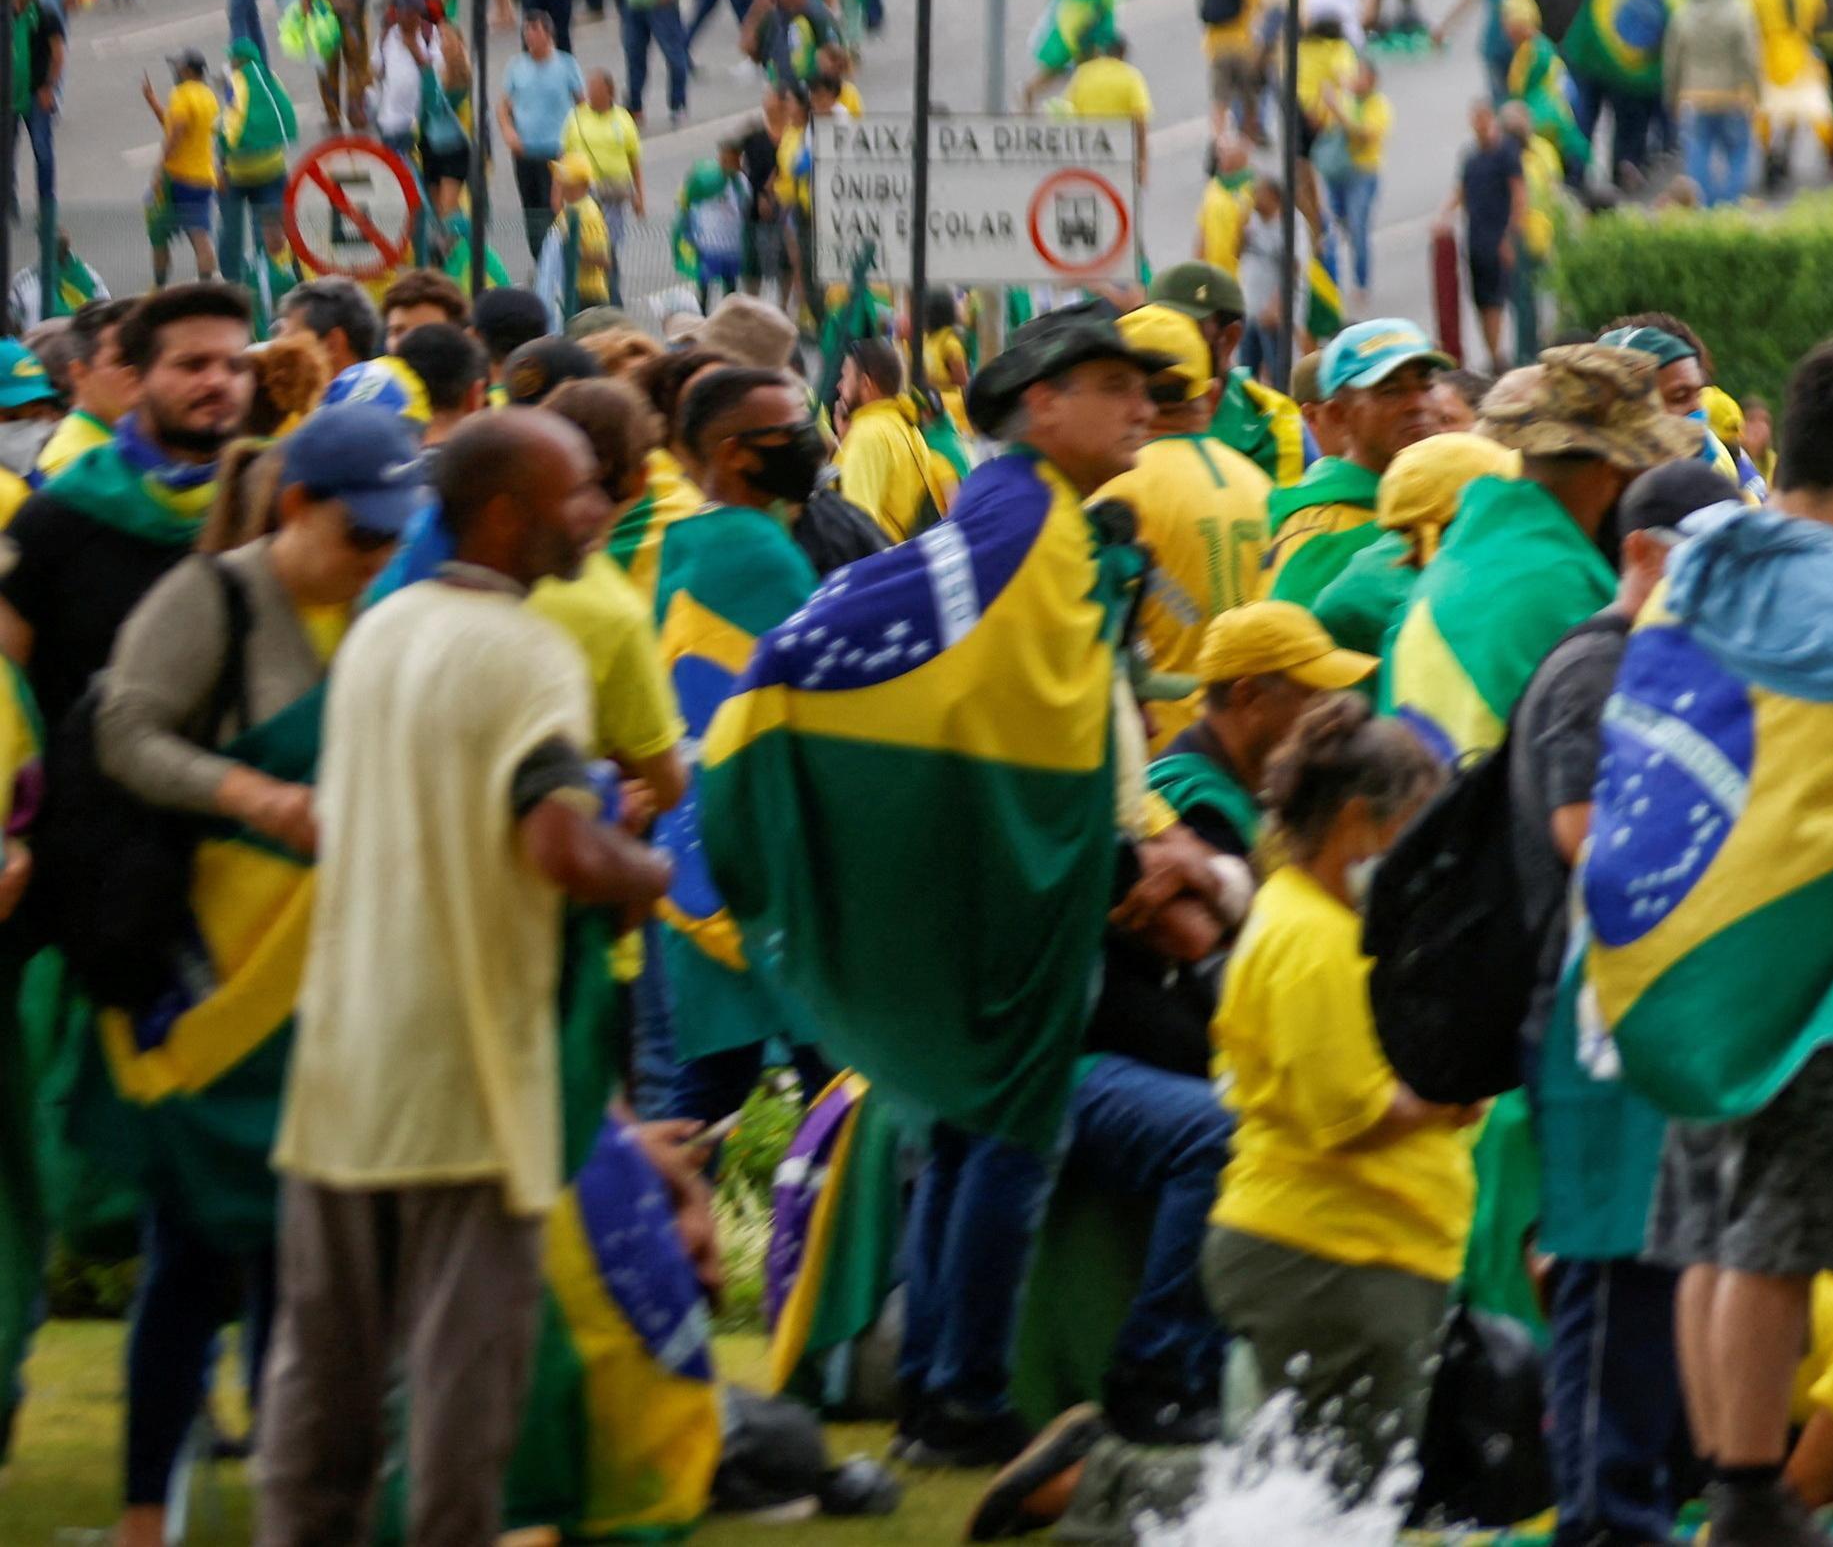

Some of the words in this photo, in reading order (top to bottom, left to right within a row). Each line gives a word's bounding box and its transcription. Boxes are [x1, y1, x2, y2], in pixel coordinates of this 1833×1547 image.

[939, 125, 979, 152] DA
[994, 125, 1113, 152] DIREITA
[831, 165, 908, 201] ÔNIBU
[331, 172, 373, 244] E
[831, 212, 881, 237] VAN
[896, 212, 1014, 237] ECOLAR
